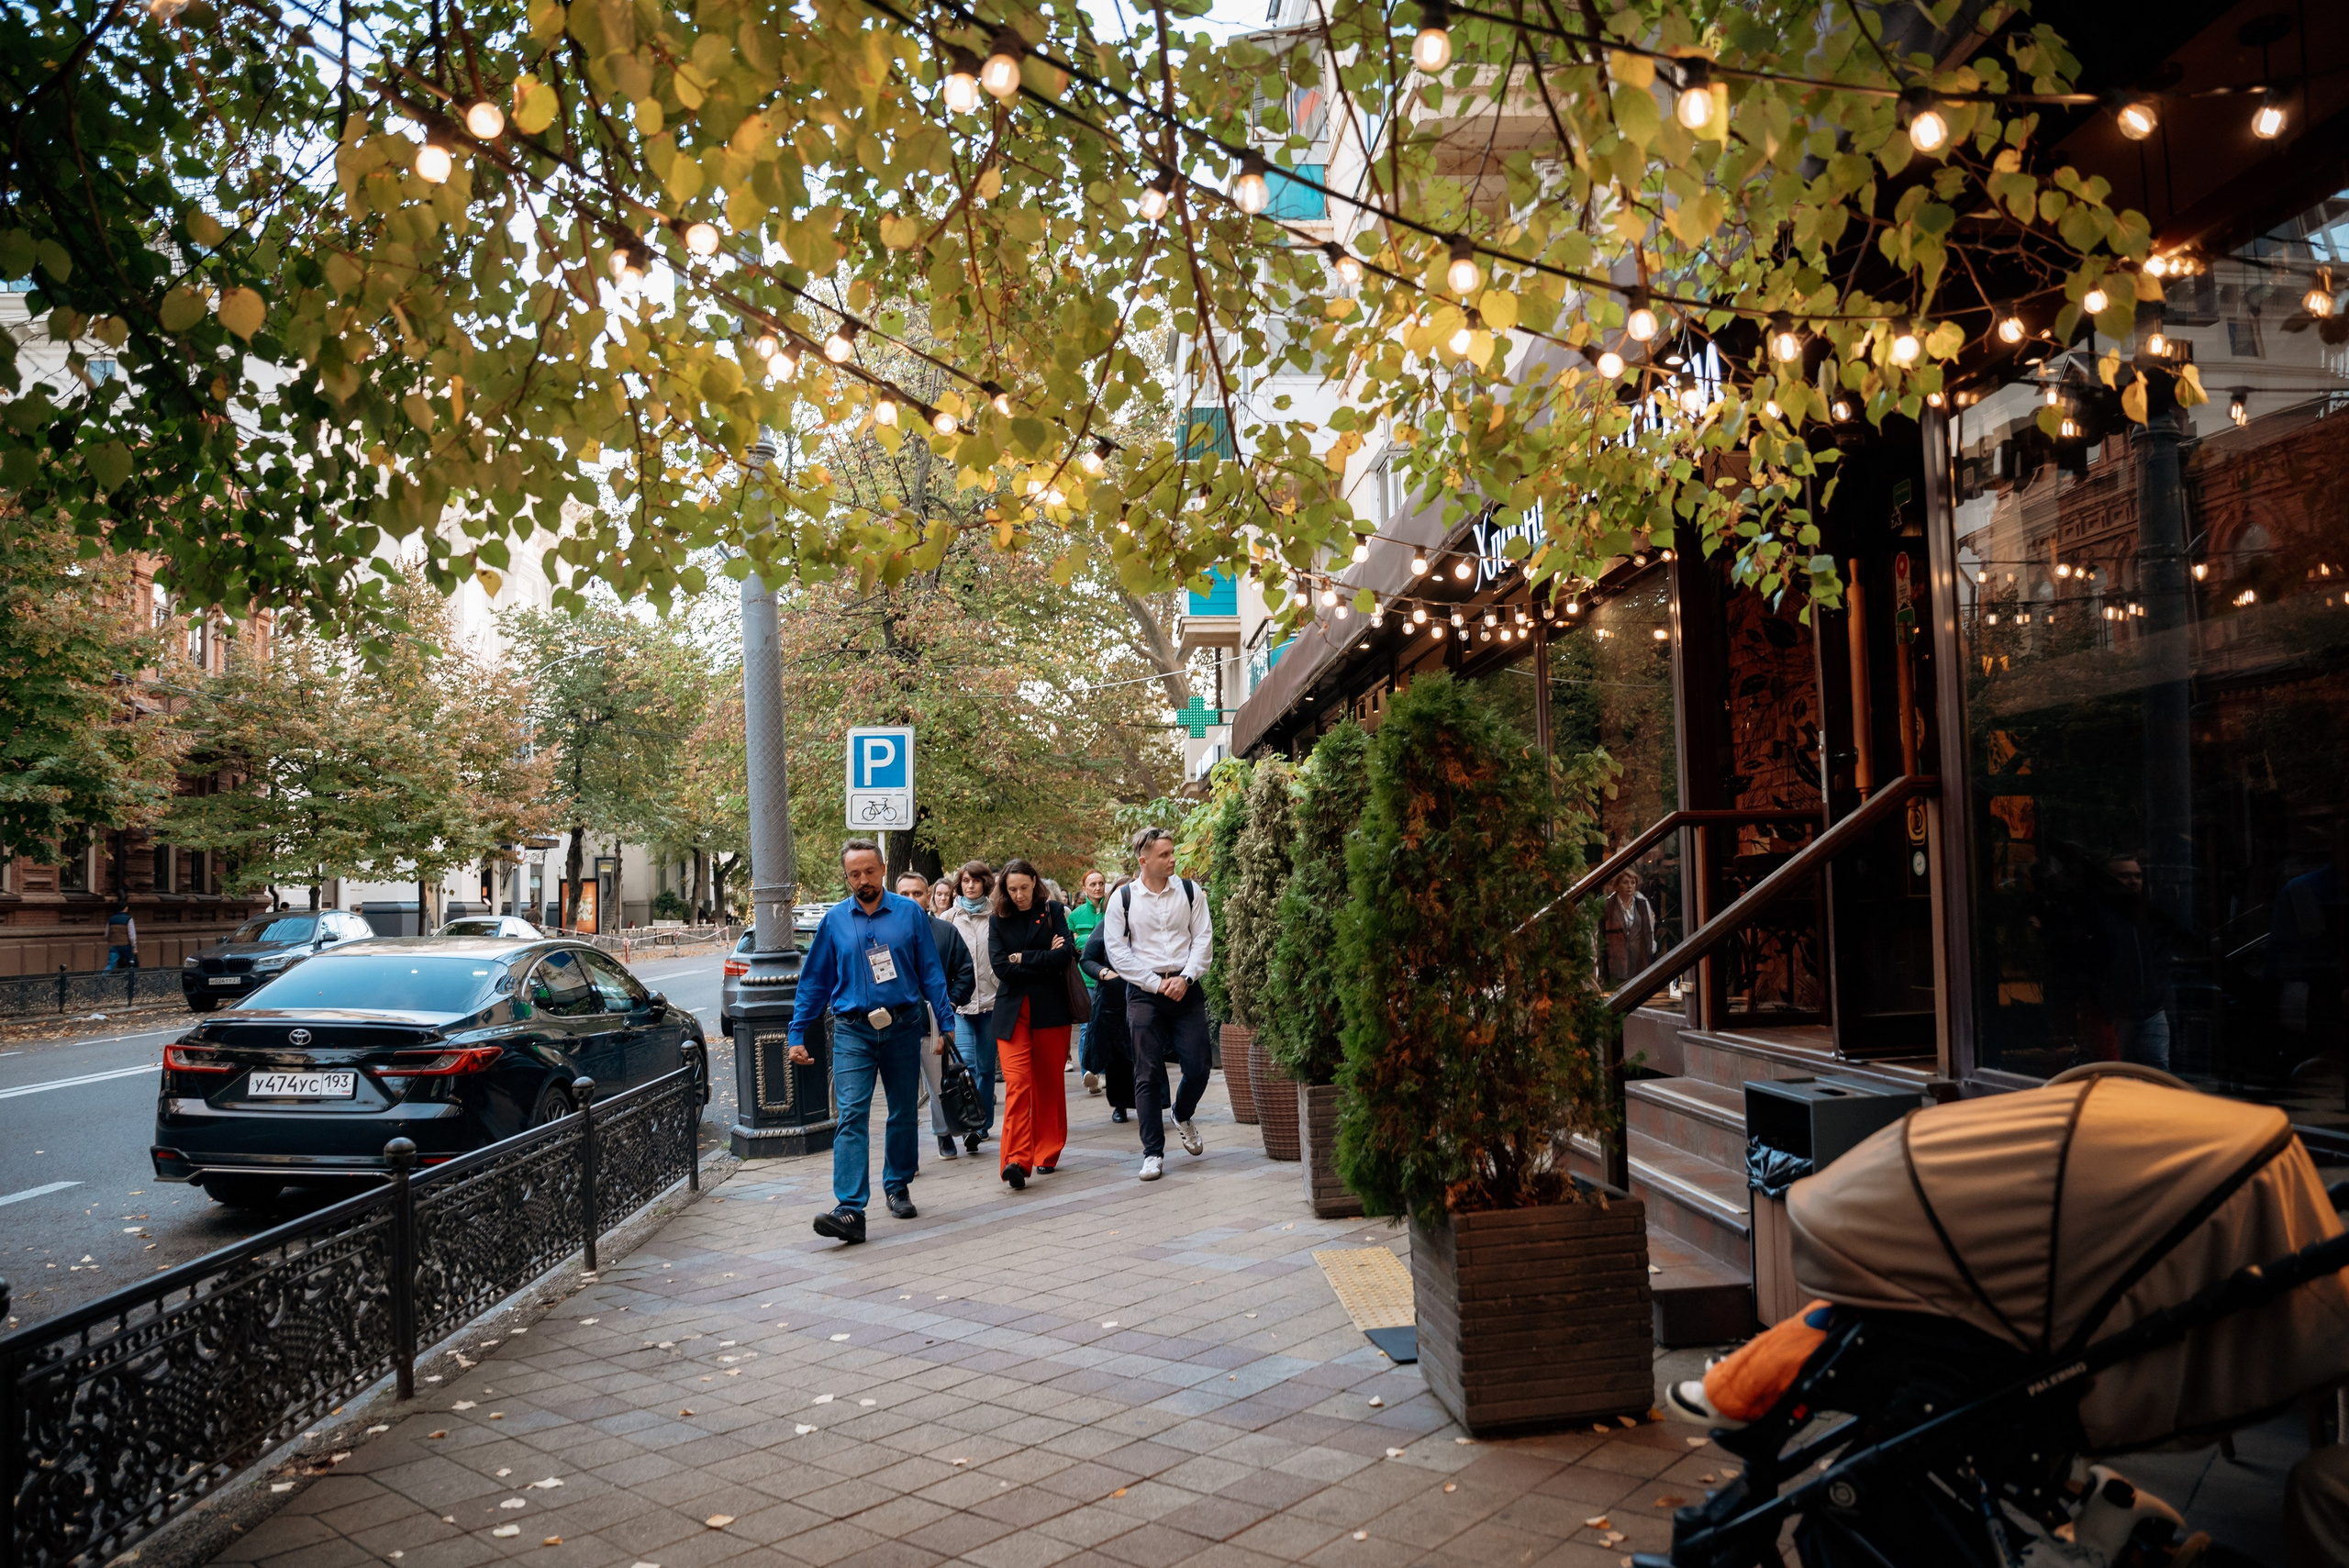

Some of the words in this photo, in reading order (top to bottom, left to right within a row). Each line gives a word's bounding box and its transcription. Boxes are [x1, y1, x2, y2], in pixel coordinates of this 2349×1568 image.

[863, 738, 896, 786] P
[255, 1075, 319, 1093] У474УС
[324, 1074, 349, 1088] 193
